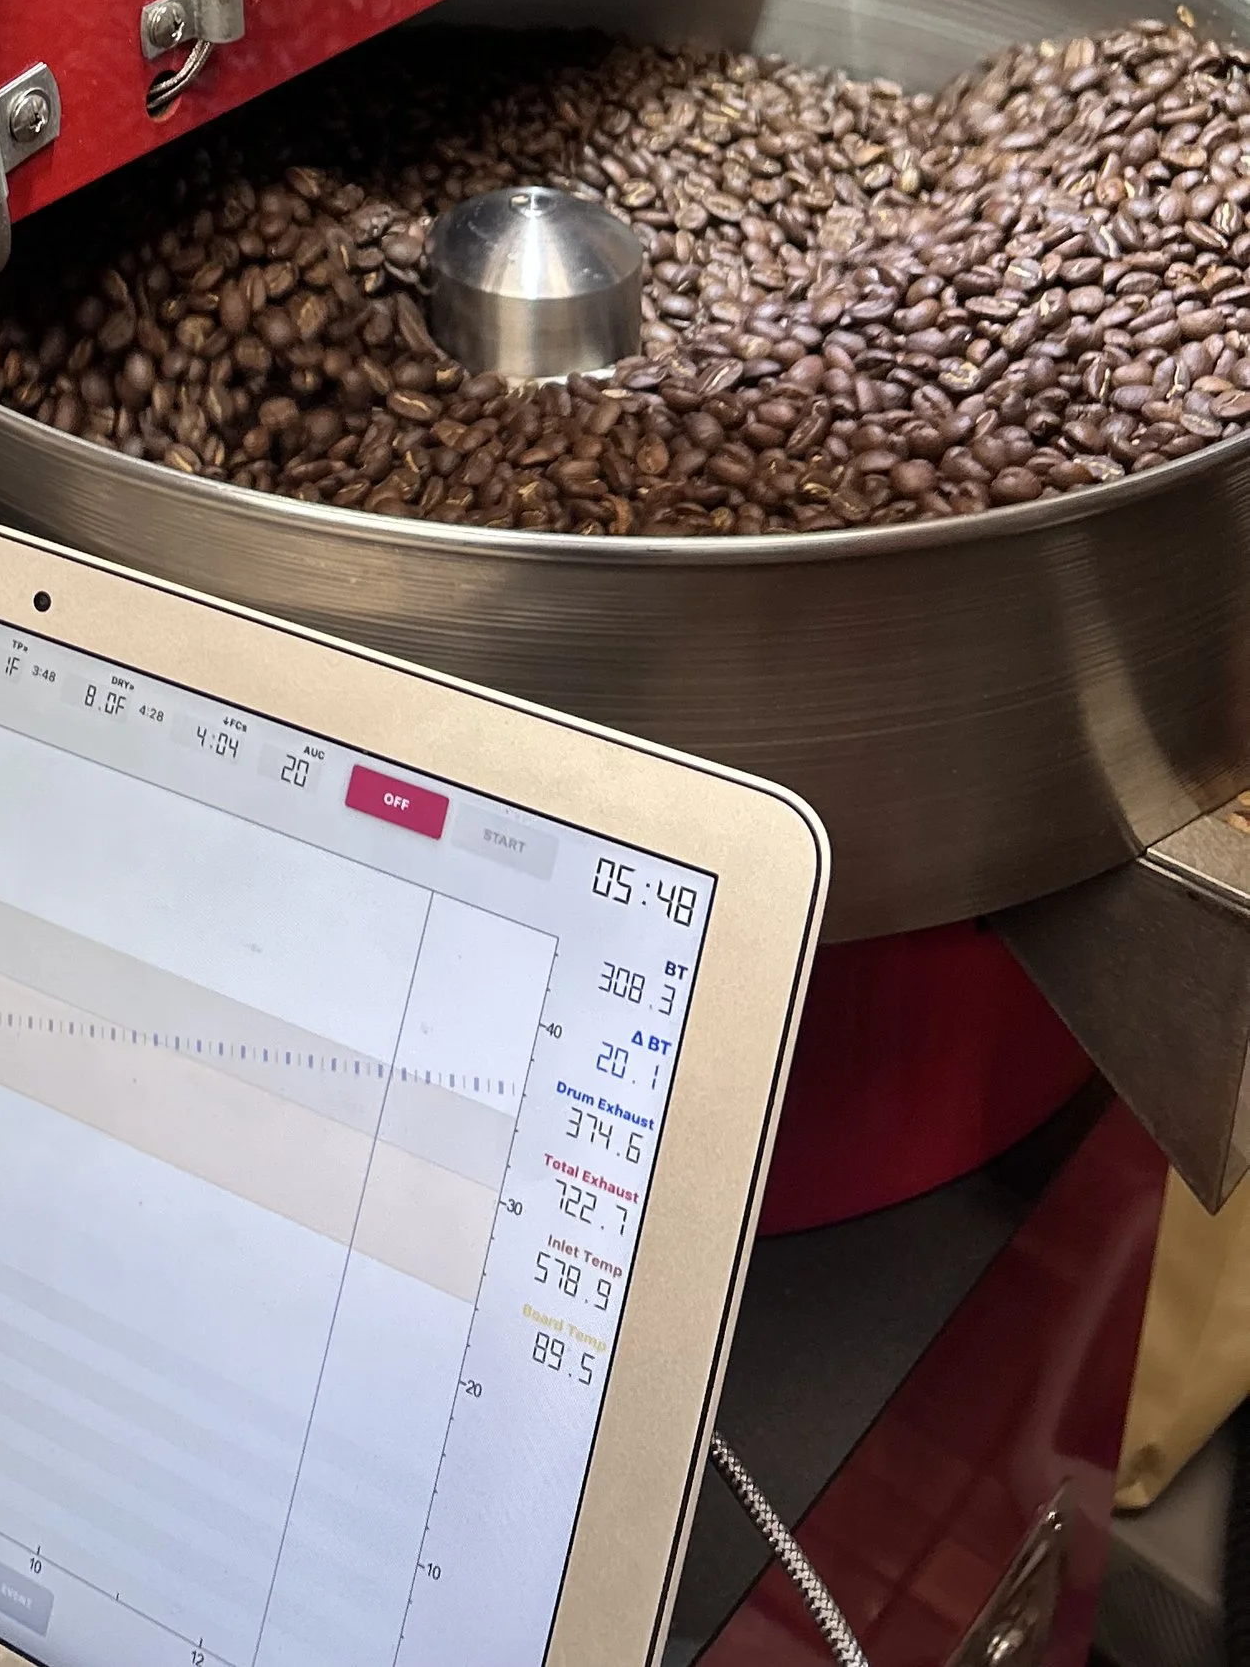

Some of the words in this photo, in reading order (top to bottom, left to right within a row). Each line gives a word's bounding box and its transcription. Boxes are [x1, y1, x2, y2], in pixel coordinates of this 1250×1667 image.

[31, 664, 57, 684] 3:48
[139, 704, 165, 723] 4:28
[196, 725, 239, 759] 4:04
[303, 745, 326, 761] AUC
[280, 754, 310, 788] 20
[382, 791, 411, 812] OFF
[483, 828, 528, 855] START
[592, 856, 698, 928] 05:48
[664, 960, 689, 981] BT
[598, 961, 677, 1016] 308.3
[545, 1022, 562, 1040] 40
[647, 1034, 673, 1056] BT
[596, 1041, 660, 1091] 20.1
[556, 1080, 595, 1107] Drum
[598, 1097, 656, 1132] Exhaust
[566, 1105, 645, 1165] 374.6
[544, 1152, 579, 1180] Total
[582, 1170, 641, 1205] Exhaust
[506, 1200, 524, 1217] 30
[554, 1178, 629, 1237] 722.7
[547, 1234, 581, 1260] Inlet
[583, 1247, 624, 1279] Temp
[533, 1250, 613, 1312] 578.9
[531, 1330, 596, 1386] 89.5
[465, 1379, 483, 1398] 20
[29, 1557, 43, 1575] 10
[426, 1562, 442, 1581] 10
[191, 1650, 204, 1667] 12
